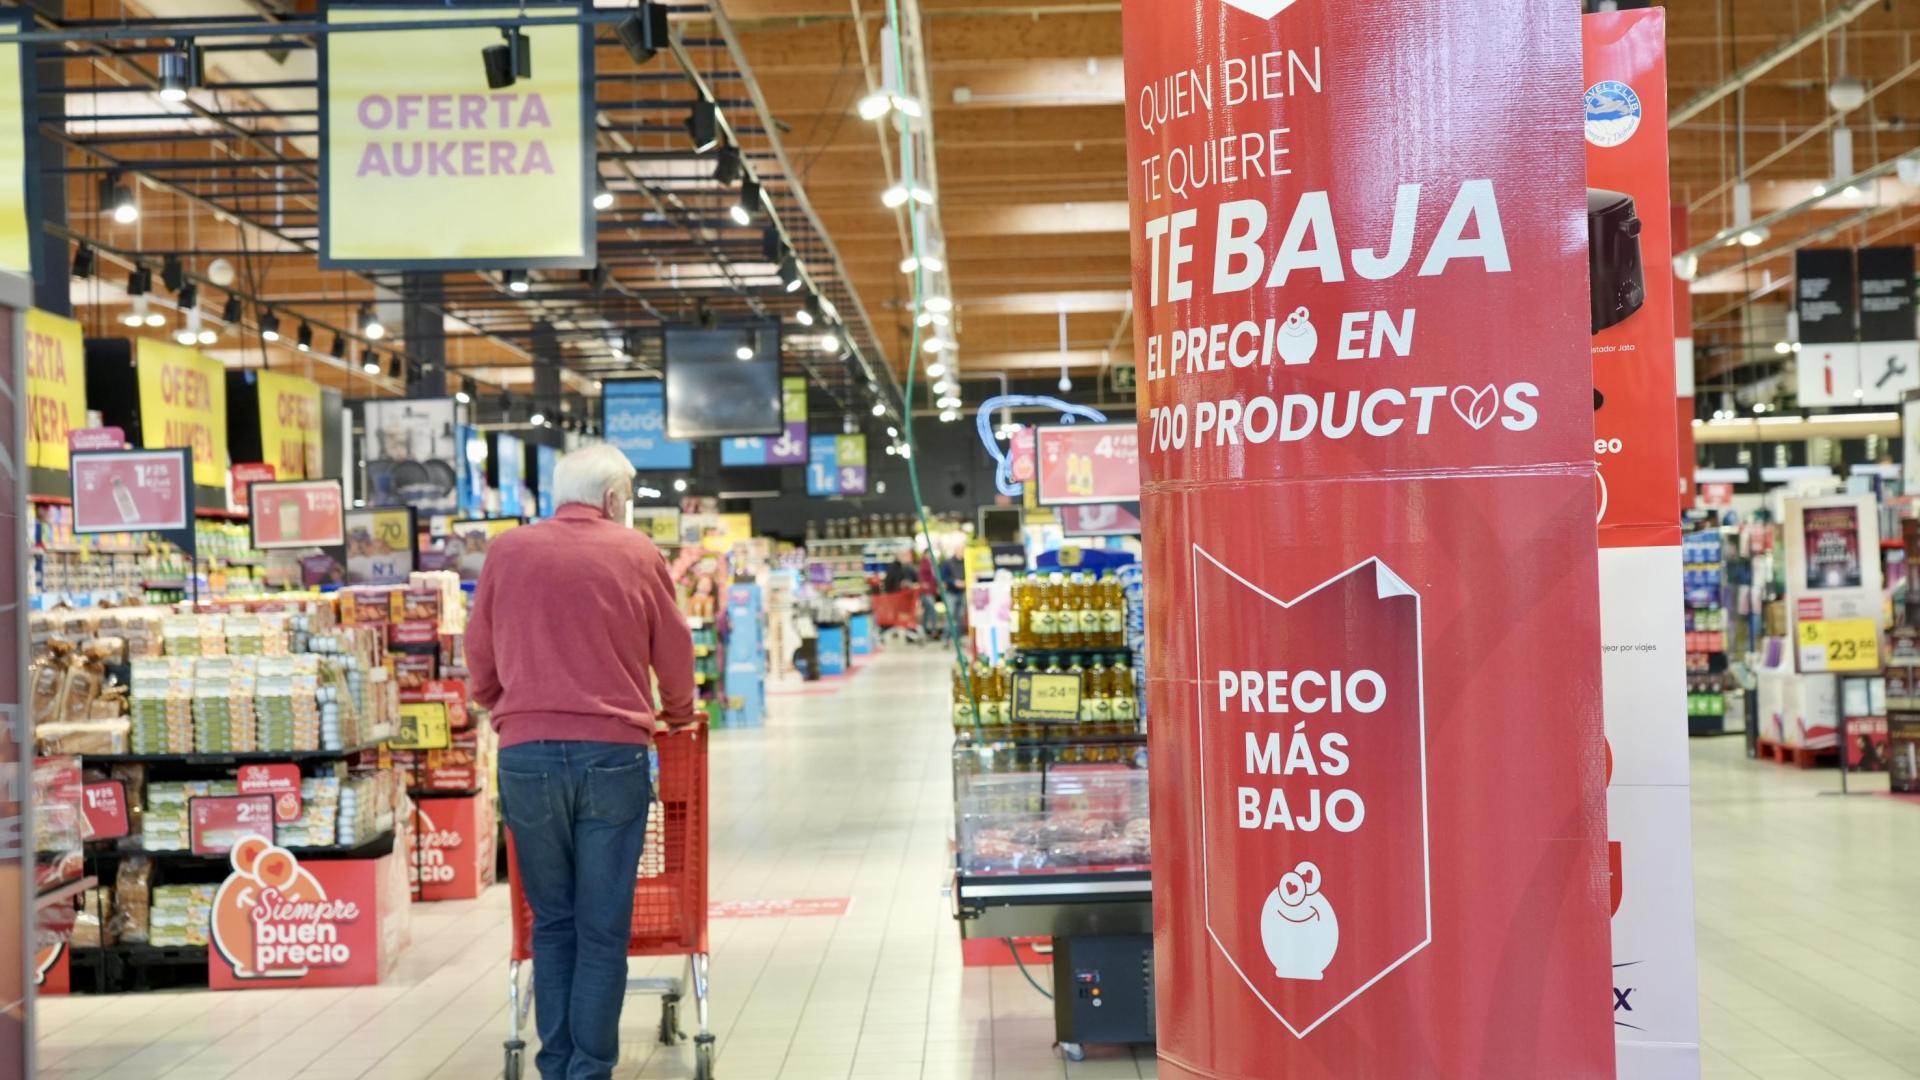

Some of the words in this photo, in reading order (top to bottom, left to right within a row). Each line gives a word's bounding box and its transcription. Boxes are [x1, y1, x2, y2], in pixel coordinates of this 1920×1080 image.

[357, 92, 552, 130] OFERTA
[1140, 63, 1213, 135] QUIEN
[1225, 46, 1321, 106] BIEN
[1613, 83, 1640, 111] CLUB
[356, 140, 554, 178] AUKERA
[1141, 154, 1162, 203] TE
[1167, 128, 1292, 199] QUIERE
[1145, 208, 1197, 307] TE
[1212, 179, 1512, 295] BAJA
[1147, 336, 1165, 381] EL
[1336, 308, 1416, 361] EN
[1149, 403, 1187, 454] 700
[1620, 645, 1633, 654] por
[1635, 643, 1657, 653] viajes
[1218, 669, 1387, 714] PRECIO
[1245, 720, 1350, 776] MÁS
[1238, 786, 1365, 832] BAJO
[256, 920, 337, 944] buen
[256, 943, 350, 971] precio
